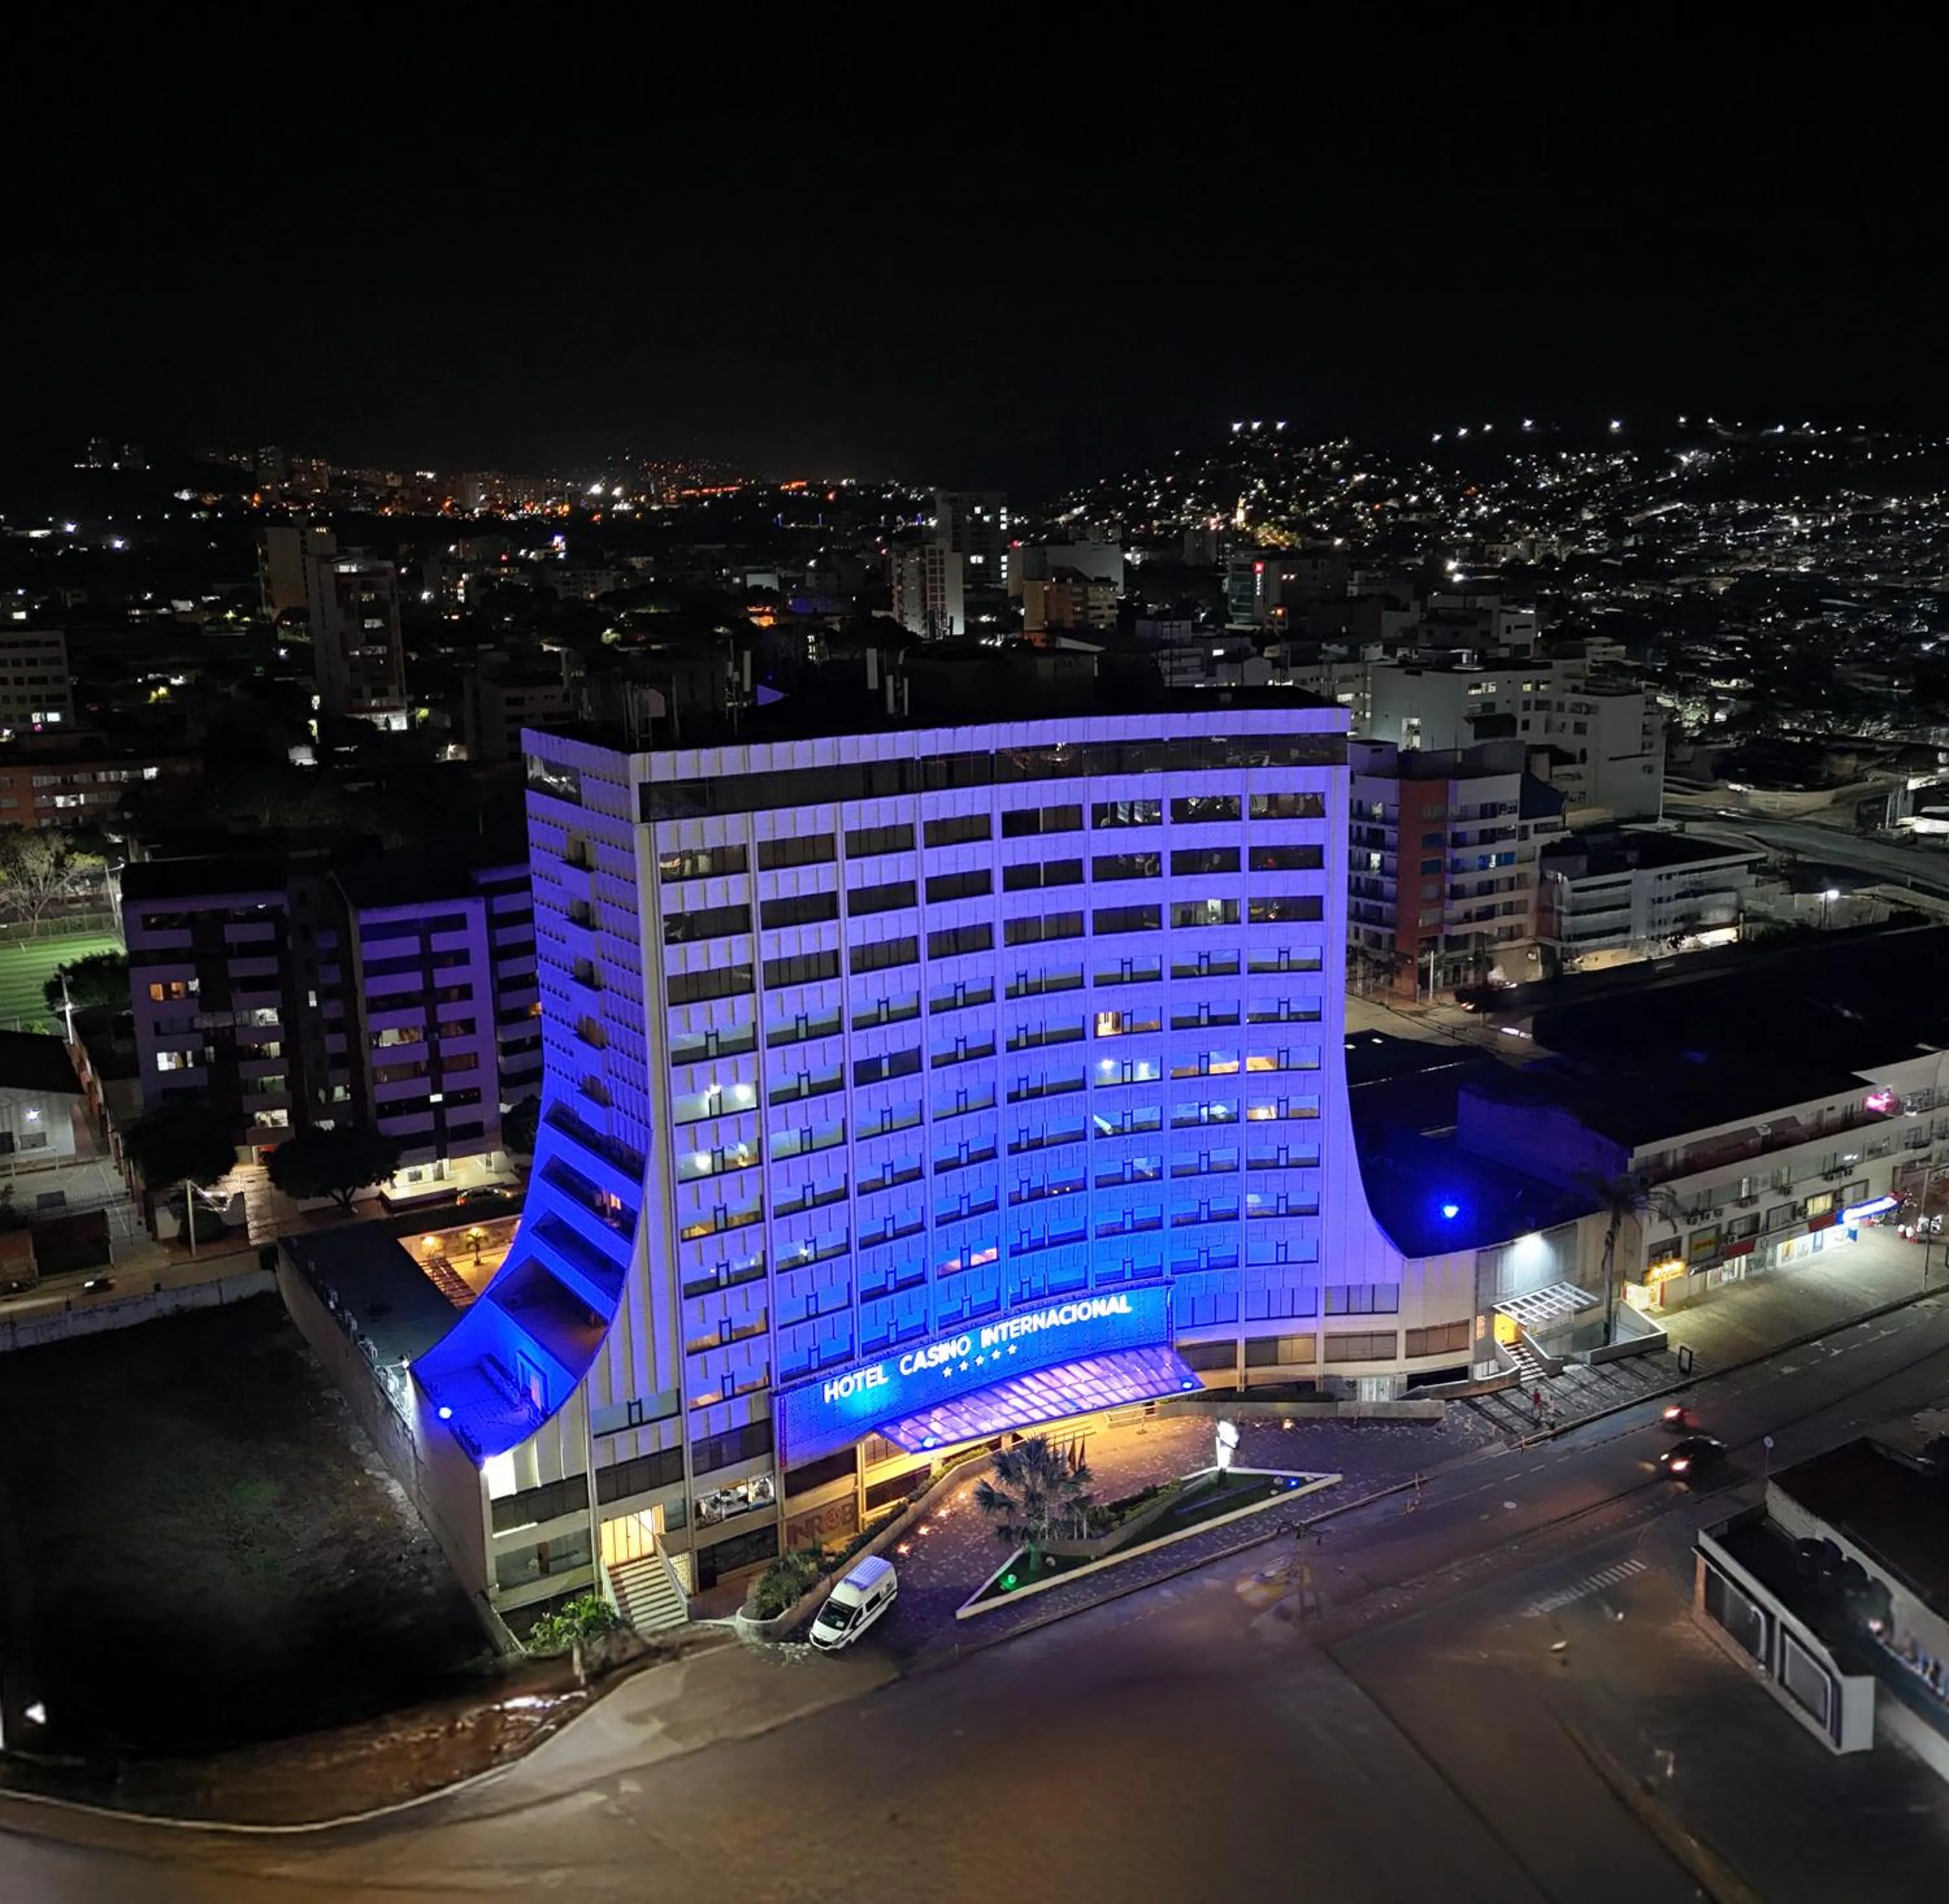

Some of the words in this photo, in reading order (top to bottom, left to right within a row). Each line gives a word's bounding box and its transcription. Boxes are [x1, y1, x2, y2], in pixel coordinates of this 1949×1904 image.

[824, 1365, 889, 1404] HOTEL
[900, 1335, 971, 1375] CASINO
[981, 1295, 1132, 1348] INTERNACIONAL
